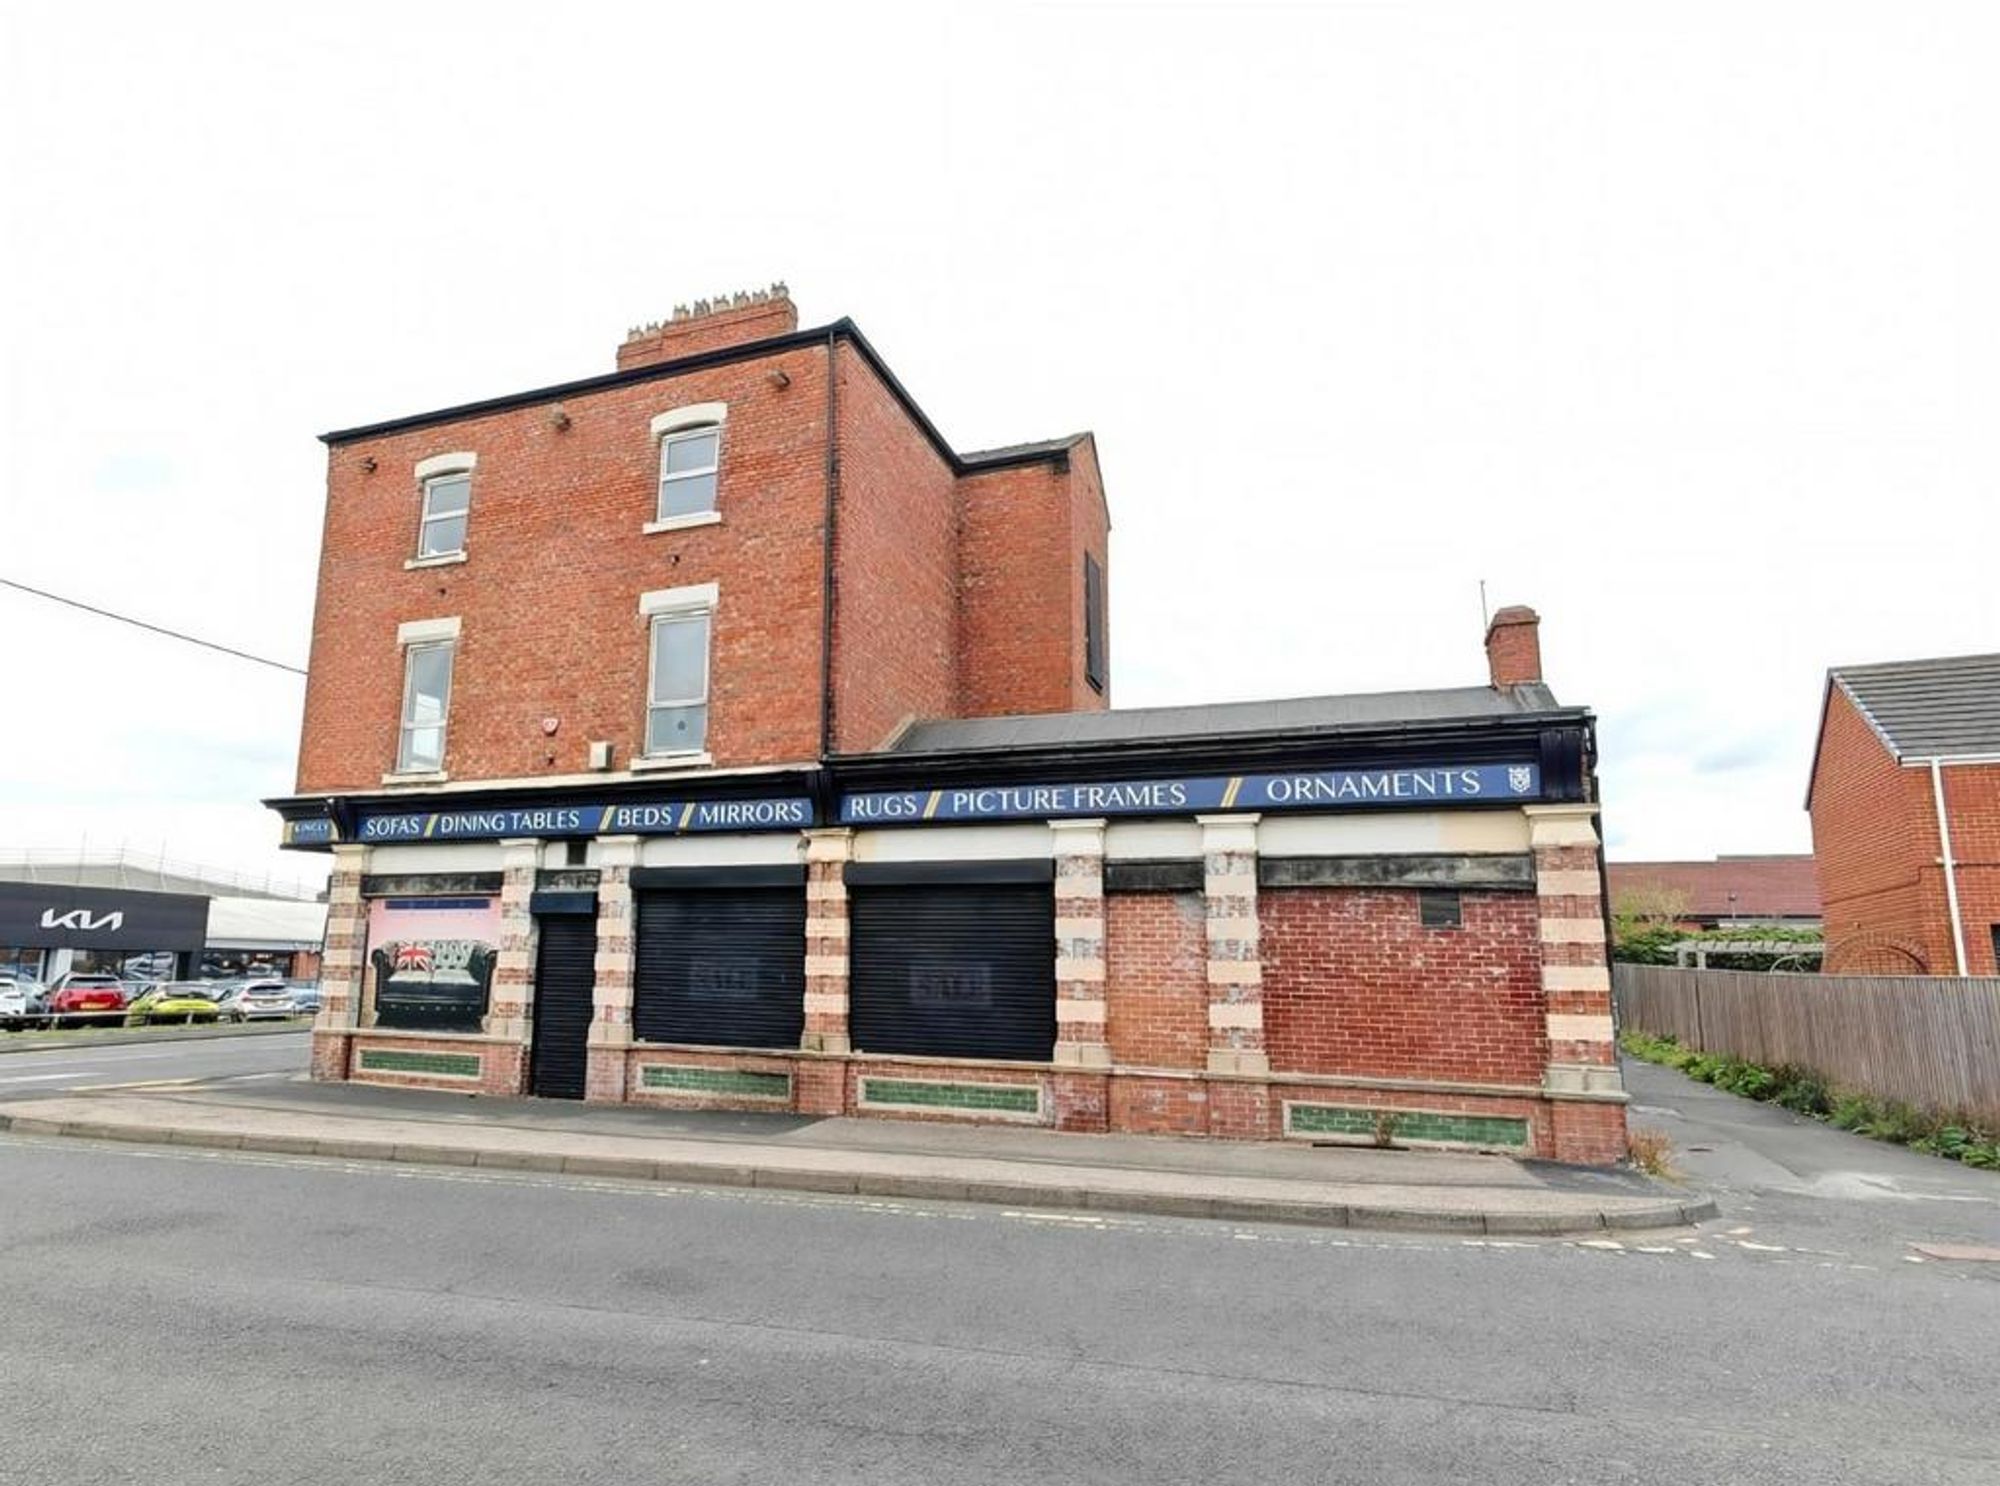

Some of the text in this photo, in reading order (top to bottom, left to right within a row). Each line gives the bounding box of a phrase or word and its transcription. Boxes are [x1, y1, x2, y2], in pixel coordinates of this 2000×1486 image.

[850, 769, 1481, 817] RUGS PICTURE FRAMES ORNAMENTS
[366, 801, 804, 836] SOFAS DINING TABLES BEDS MIRRORS
[41, 908, 124, 931] KIA
